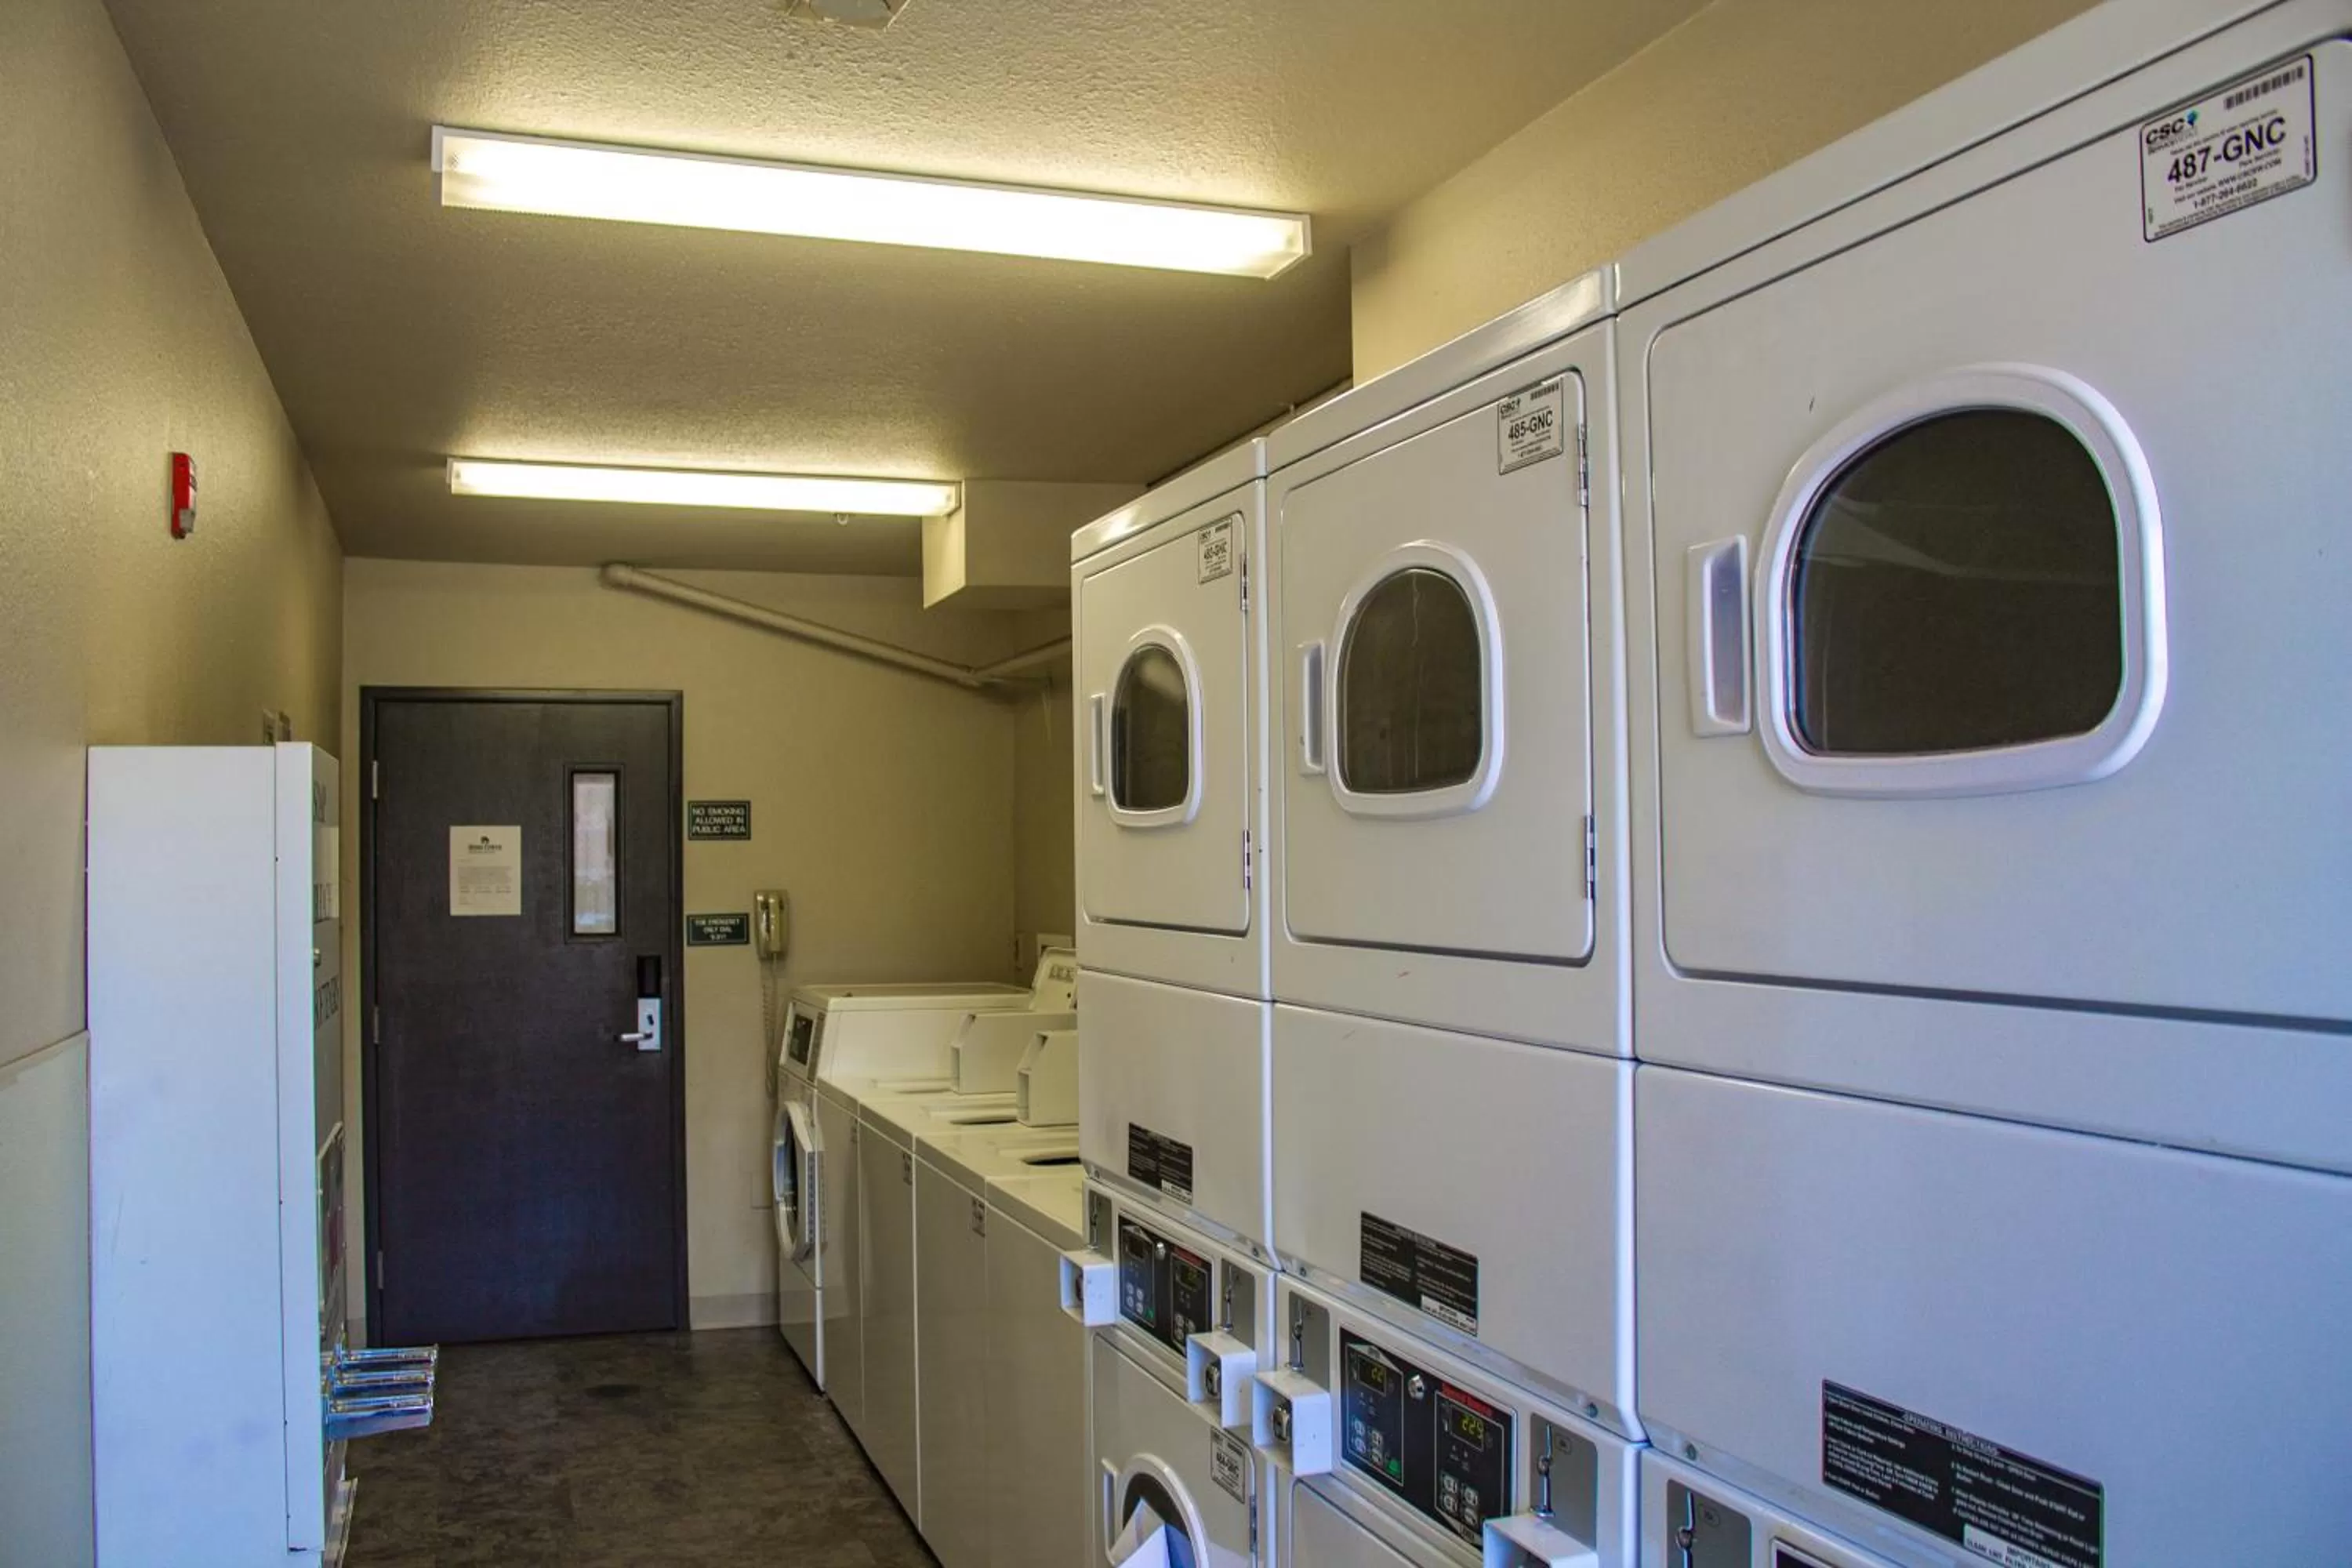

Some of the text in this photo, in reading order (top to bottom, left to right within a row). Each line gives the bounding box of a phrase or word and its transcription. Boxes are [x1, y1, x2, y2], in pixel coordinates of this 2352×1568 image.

[2146, 118, 2185, 144] CSC
[2167, 117, 2286, 183] 487-GNC
[1508, 410, 1553, 440] 485-GNC
[692, 807, 746, 816] NO SMOKING
[692, 825, 746, 834] PUBLIC AREA
[695, 816, 745, 826] ALLOWED IN
